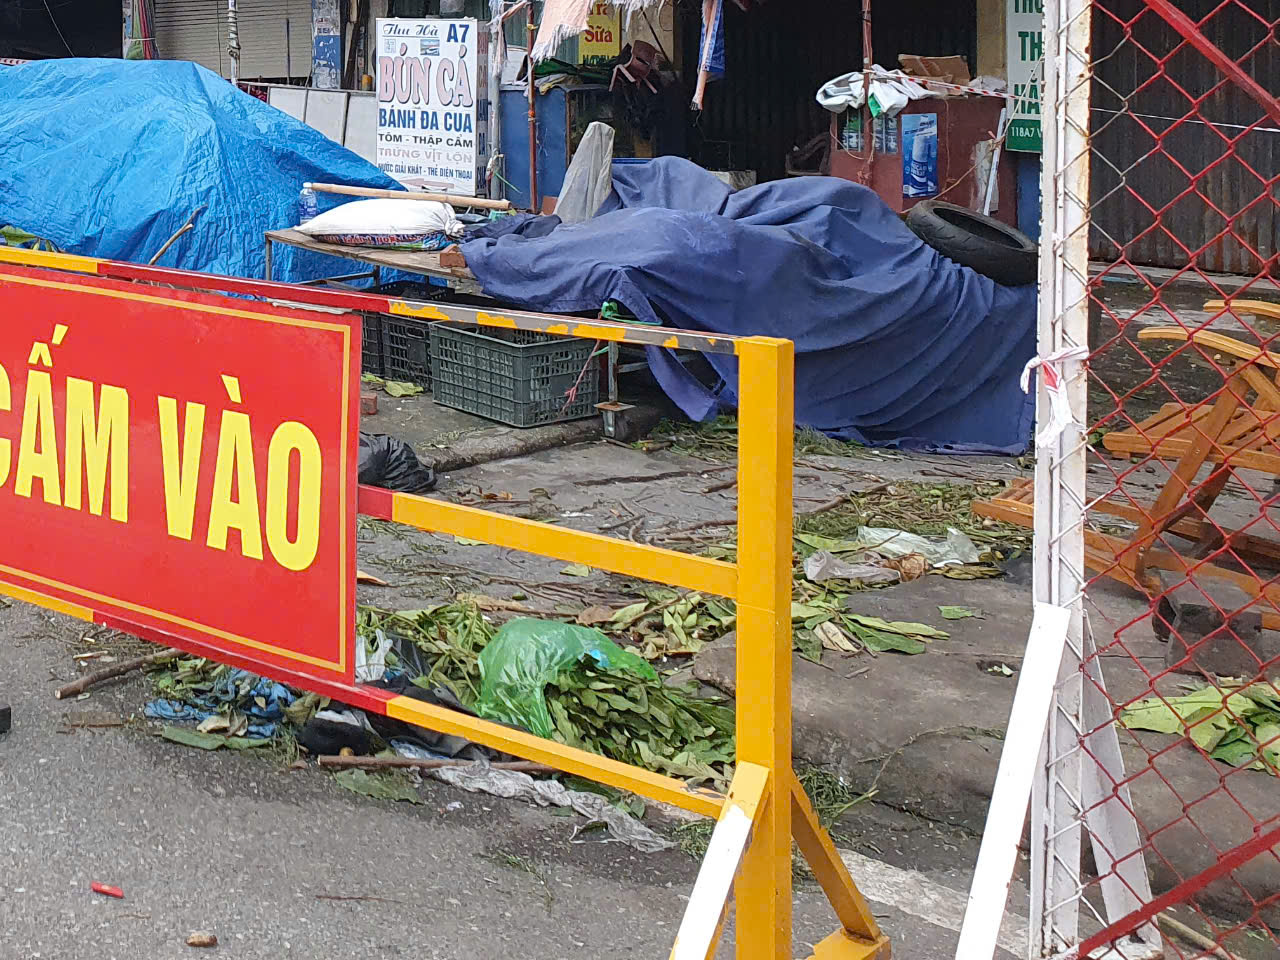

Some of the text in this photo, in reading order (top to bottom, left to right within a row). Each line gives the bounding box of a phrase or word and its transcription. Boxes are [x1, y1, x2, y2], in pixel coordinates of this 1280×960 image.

[382, 23, 439, 37] Thu Hà
[446, 23, 470, 43] A7
[1018, 31, 1043, 61] TH
[379, 42, 473, 108] BÚN CÁ
[379, 105, 472, 133] BÁNH ĐA CUA
[378, 132, 403, 143] TÔM
[413, 134, 443, 148] THẬP
[1010, 125, 1034, 138] 118A7
[424, 148, 443, 163] VỊT
[157, 373, 322, 572] VÀO
